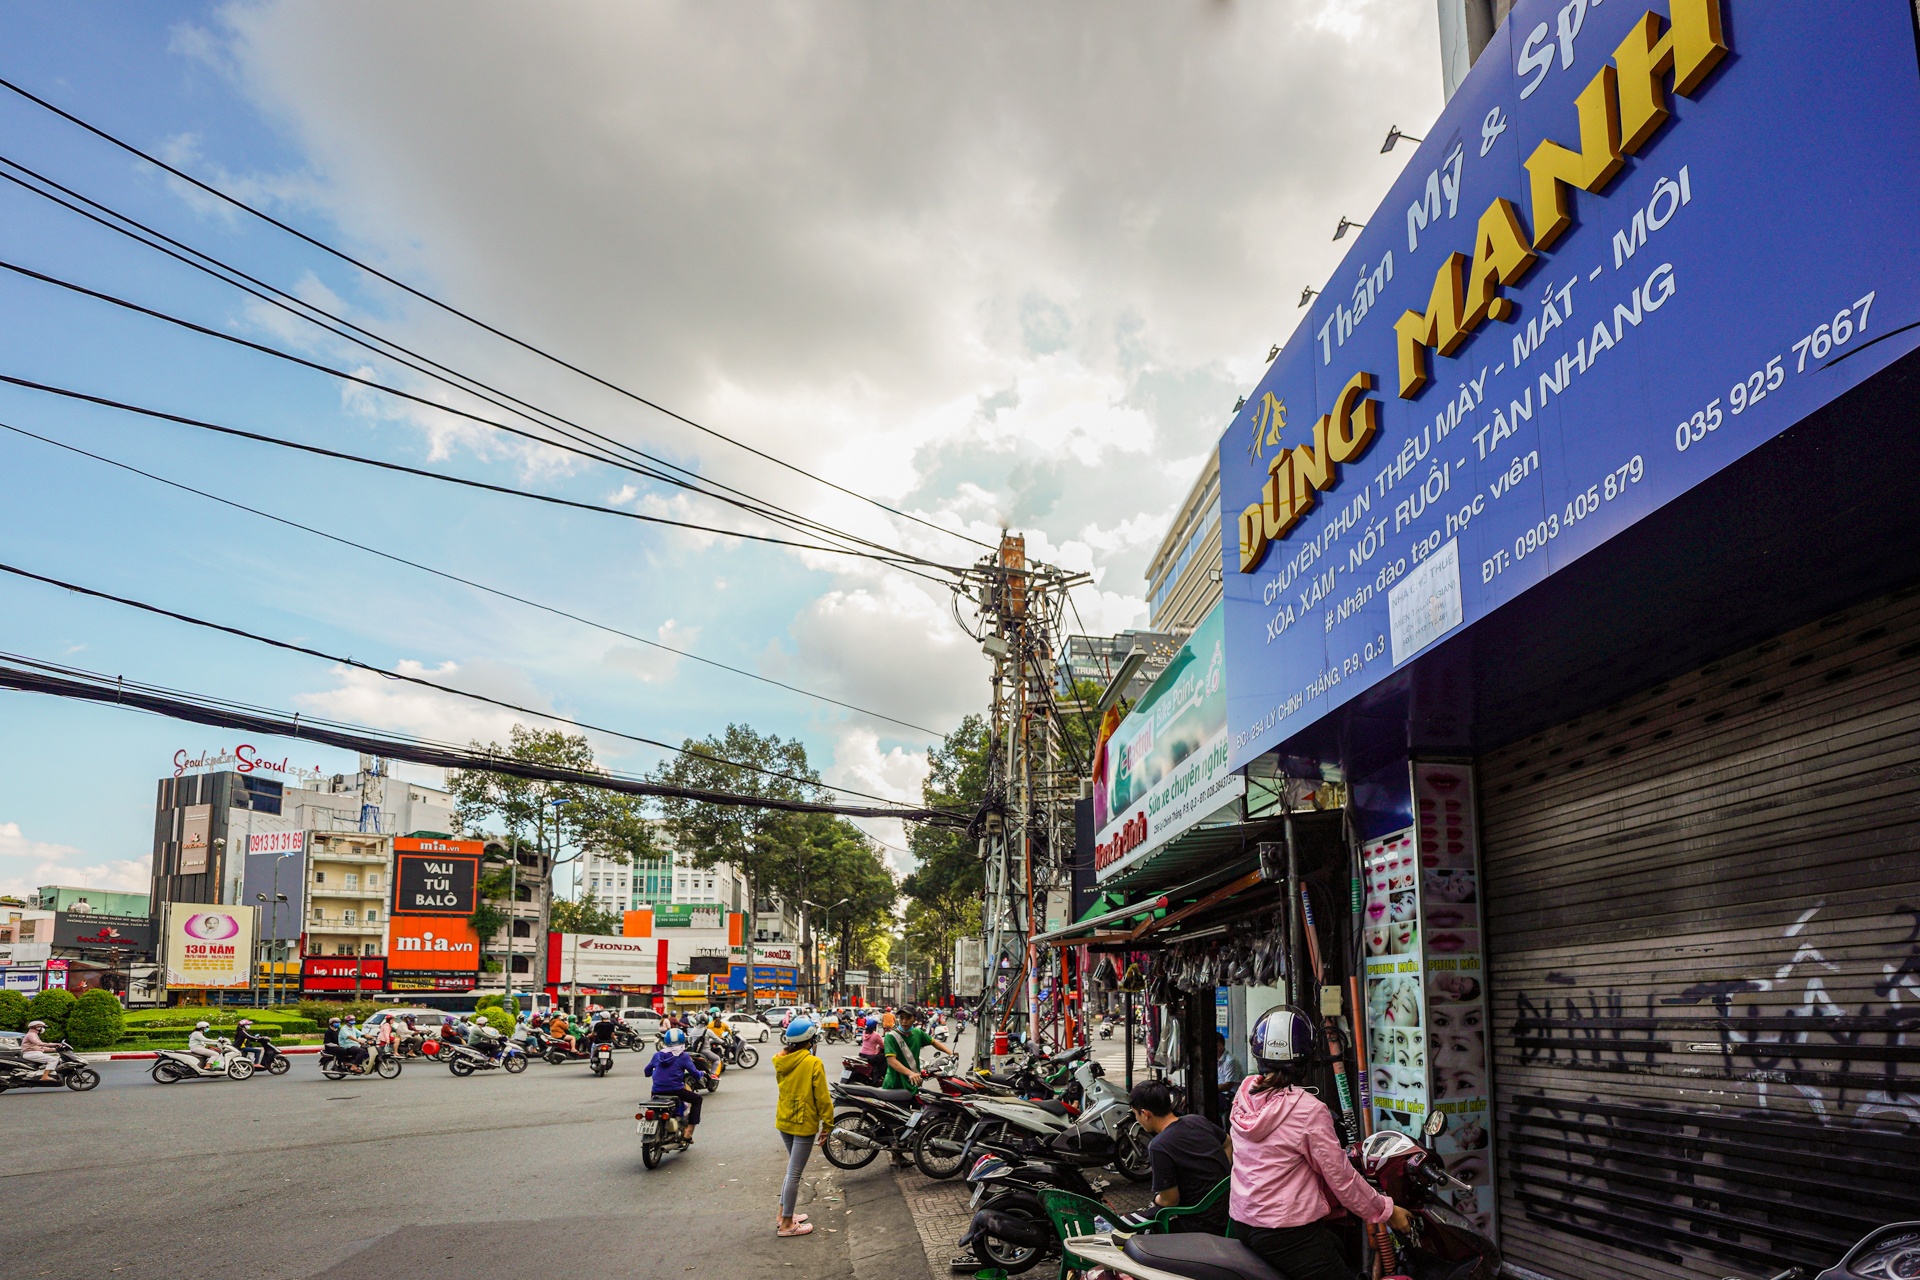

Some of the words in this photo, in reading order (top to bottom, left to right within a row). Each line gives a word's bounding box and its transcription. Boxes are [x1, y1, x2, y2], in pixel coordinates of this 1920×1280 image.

[1317, 250, 1394, 366] Thẩm
[1406, 142, 1464, 253] Mỹ
[1480, 106, 1507, 158] &
[1517, 0, 1602, 100] Sp
[1393, 0, 1728, 399] MẠNH
[1675, 398, 1723, 452] 035
[1729, 354, 1785, 416] 925
[1791, 290, 1876, 374] 7667
[1263, 534, 1321, 606] CHUYÊN
[1323, 485, 1371, 551] PHUN
[1375, 425, 1431, 498] THÊU
[1436, 365, 1489, 444] MÀY
[1512, 274, 1578, 369] MẮT
[1612, 164, 1692, 271] MÔI
[1266, 604, 1296, 645] XÓA
[1300, 566, 1336, 617] XĂM
[1350, 516, 1389, 573] NỐT
[1395, 457, 1450, 534] RUỒI
[1472, 386, 1533, 462] TÀN
[1539, 262, 1676, 408] NHANG
[1482, 549, 1510, 584] ĐT:
[1515, 513, 1559, 561] 0903
[1563, 485, 1600, 528] 405
[1604, 454, 1645, 502] 879
[1337, 583, 1373, 625] Nhận
[1376, 557, 1406, 593] đào
[1411, 529, 1441, 564] tạo
[1446, 493, 1485, 538] học
[1144, 656, 1174, 664] APEL
[1075, 667, 1101, 676] TRUNG
[1251, 719, 1264, 740] 254
[1266, 707, 1277, 730] LÝ
[1278, 691, 1303, 721] CHÍNH
[1343, 653, 1363, 677] P.9,
[1364, 634, 1385, 662] Q.3
[1156, 699, 1171, 728] Bike
[1172, 672, 1195, 710] Point
[1127, 722, 1151, 771] Castrol
[173, 749, 206, 778] Seoul
[235, 744, 289, 773] Seoul
[1161, 788, 1170, 808] xe
[1171, 763, 1200, 800] chuyên
[1201, 736, 1228, 781] nghiệ
[250, 834, 269, 851] 0913
[269, 833, 280, 850] 31
[281, 832, 291, 850] 31
[292, 831, 302, 849] 69
[420, 840, 460, 851] mia.vn
[424, 862, 453, 875] VALI
[424, 876, 450, 890] TÚI
[416, 892, 458, 906] BALÔ
[185, 944, 207, 954] 130
[209, 944, 235, 954] NĂM
[396, 932, 473, 952] mia.vn
[593, 943, 642, 952] HONDA
[731, 946, 747, 955] Miễ
[1367, 962, 1395, 975] PHUN
[1398, 959, 1419, 973] MÔI
[1428, 959, 1457, 971] PHUN
[1460, 957, 1480, 970] MÔI
[1374, 1096, 1398, 1110] PHUN
[1399, 1098, 1406, 1111] MÍ
[1407, 1100, 1425, 1114] MẮT
[1434, 1102, 1457, 1114] PHUN
[1458, 1099, 1469, 1113] MÍ
[1470, 1098, 1487, 1112] MẮT
